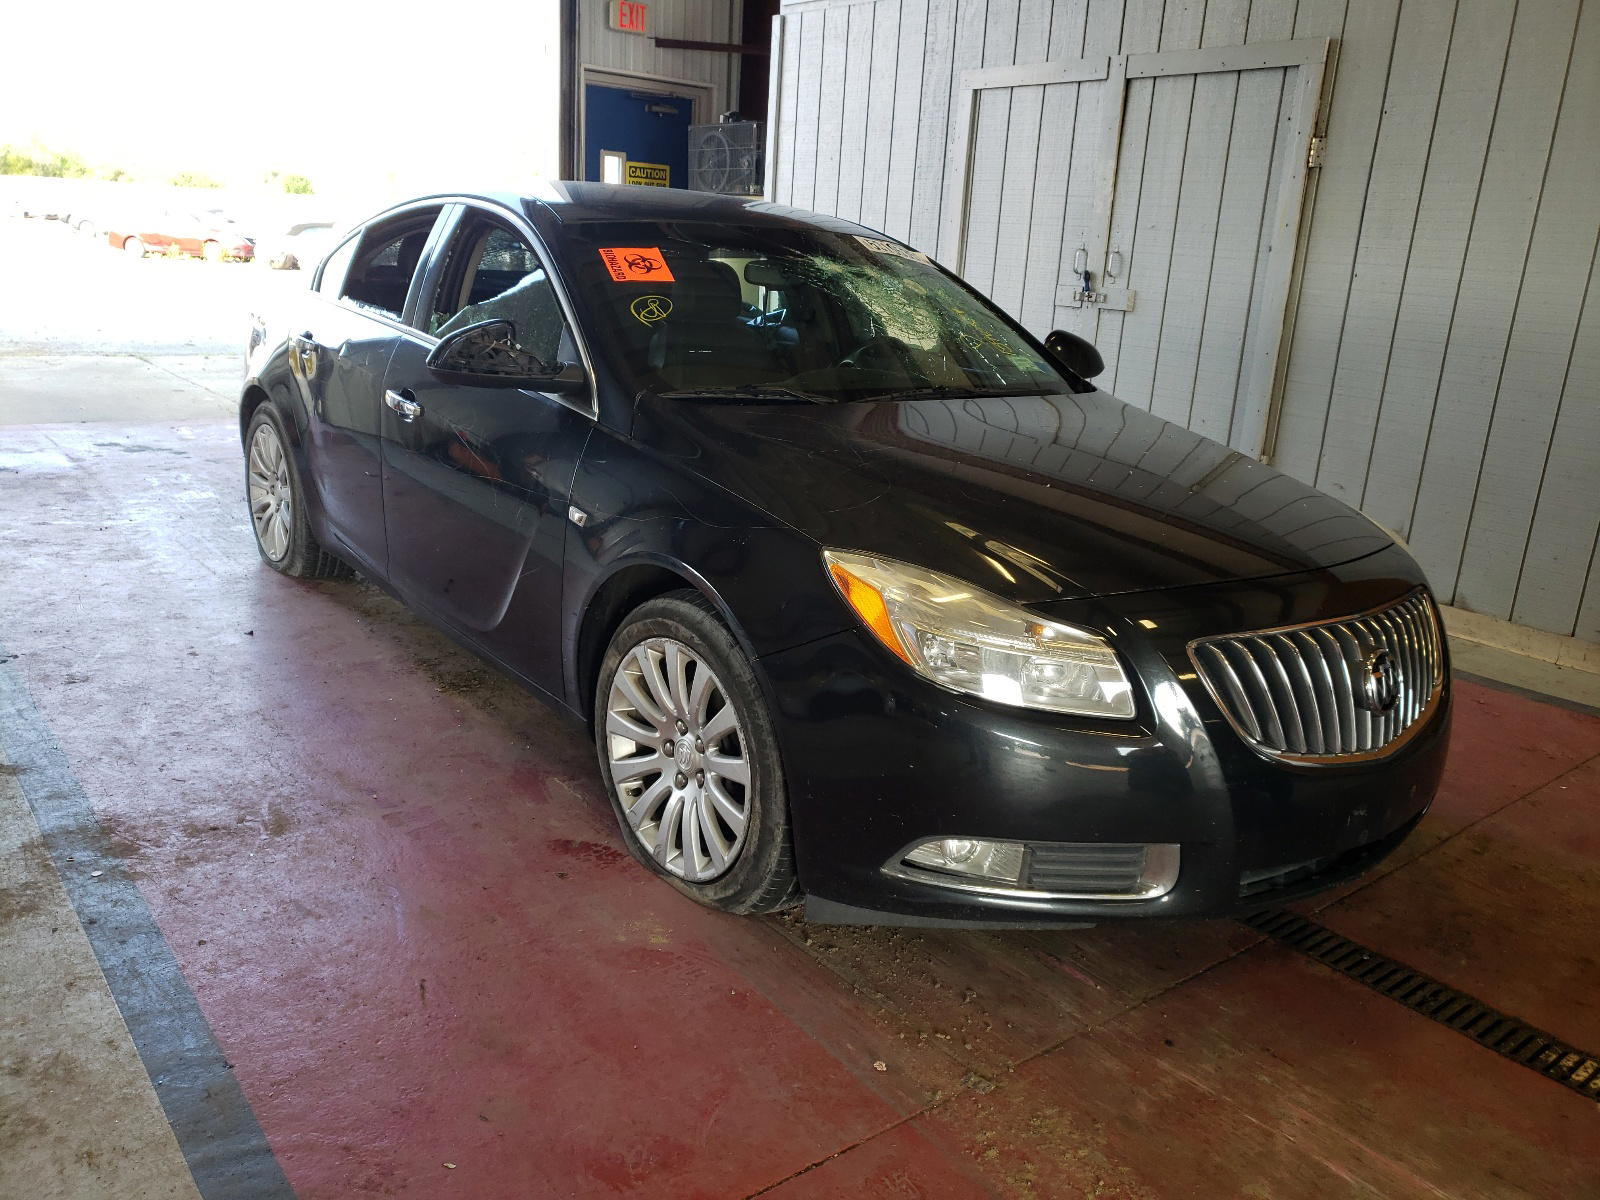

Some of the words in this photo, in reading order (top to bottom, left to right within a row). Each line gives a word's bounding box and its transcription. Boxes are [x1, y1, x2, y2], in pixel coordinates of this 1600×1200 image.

[619, 0, 648, 32] EXIT
[629, 167, 666, 179] CAUTION
[602, 249, 627, 280] BIOHAZARD
